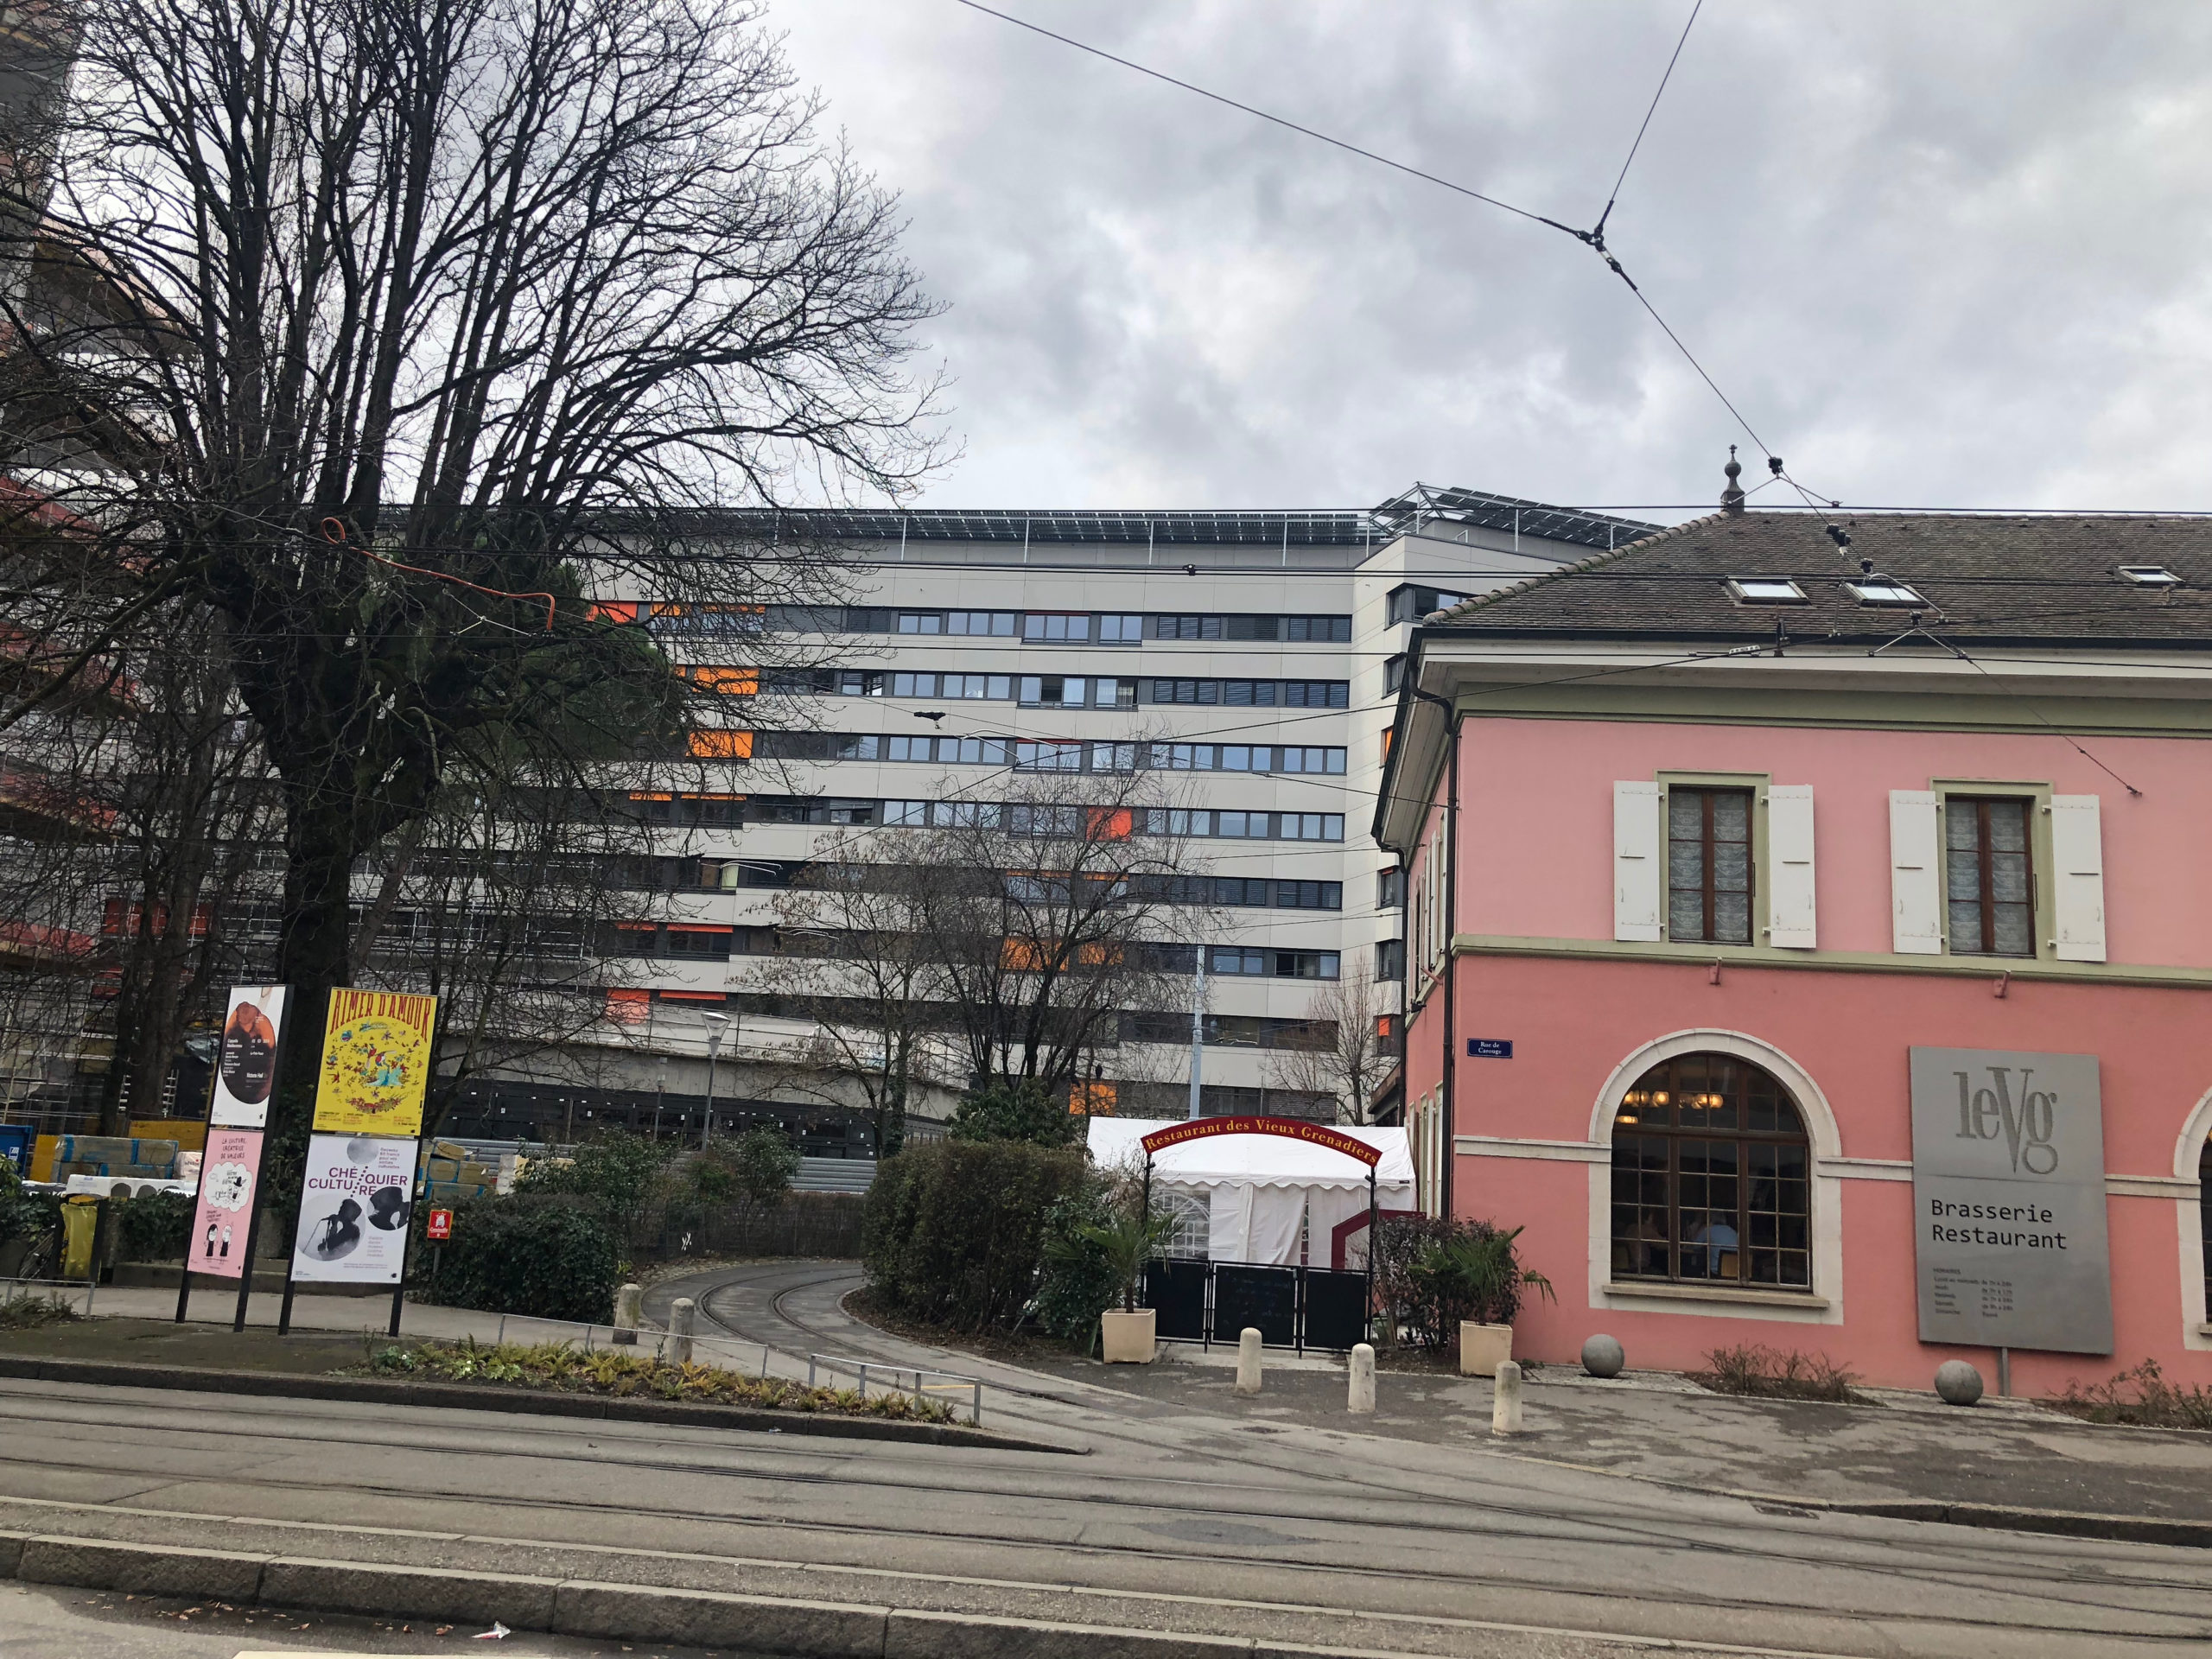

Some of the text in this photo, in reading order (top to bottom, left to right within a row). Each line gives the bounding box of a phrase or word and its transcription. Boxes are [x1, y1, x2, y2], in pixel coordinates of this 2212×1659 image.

[330, 990, 431, 1043] AIMER D'AMOUR
[1145, 1119, 1377, 1164] Restaurant des Vieux Grenadiers
[308, 1178, 377, 1196] CULTU RE
[365, 1173, 408, 1185] QUIER
[1931, 1198, 2053, 1223] Brasserie
[1932, 1224, 2068, 1249] Restaurant
